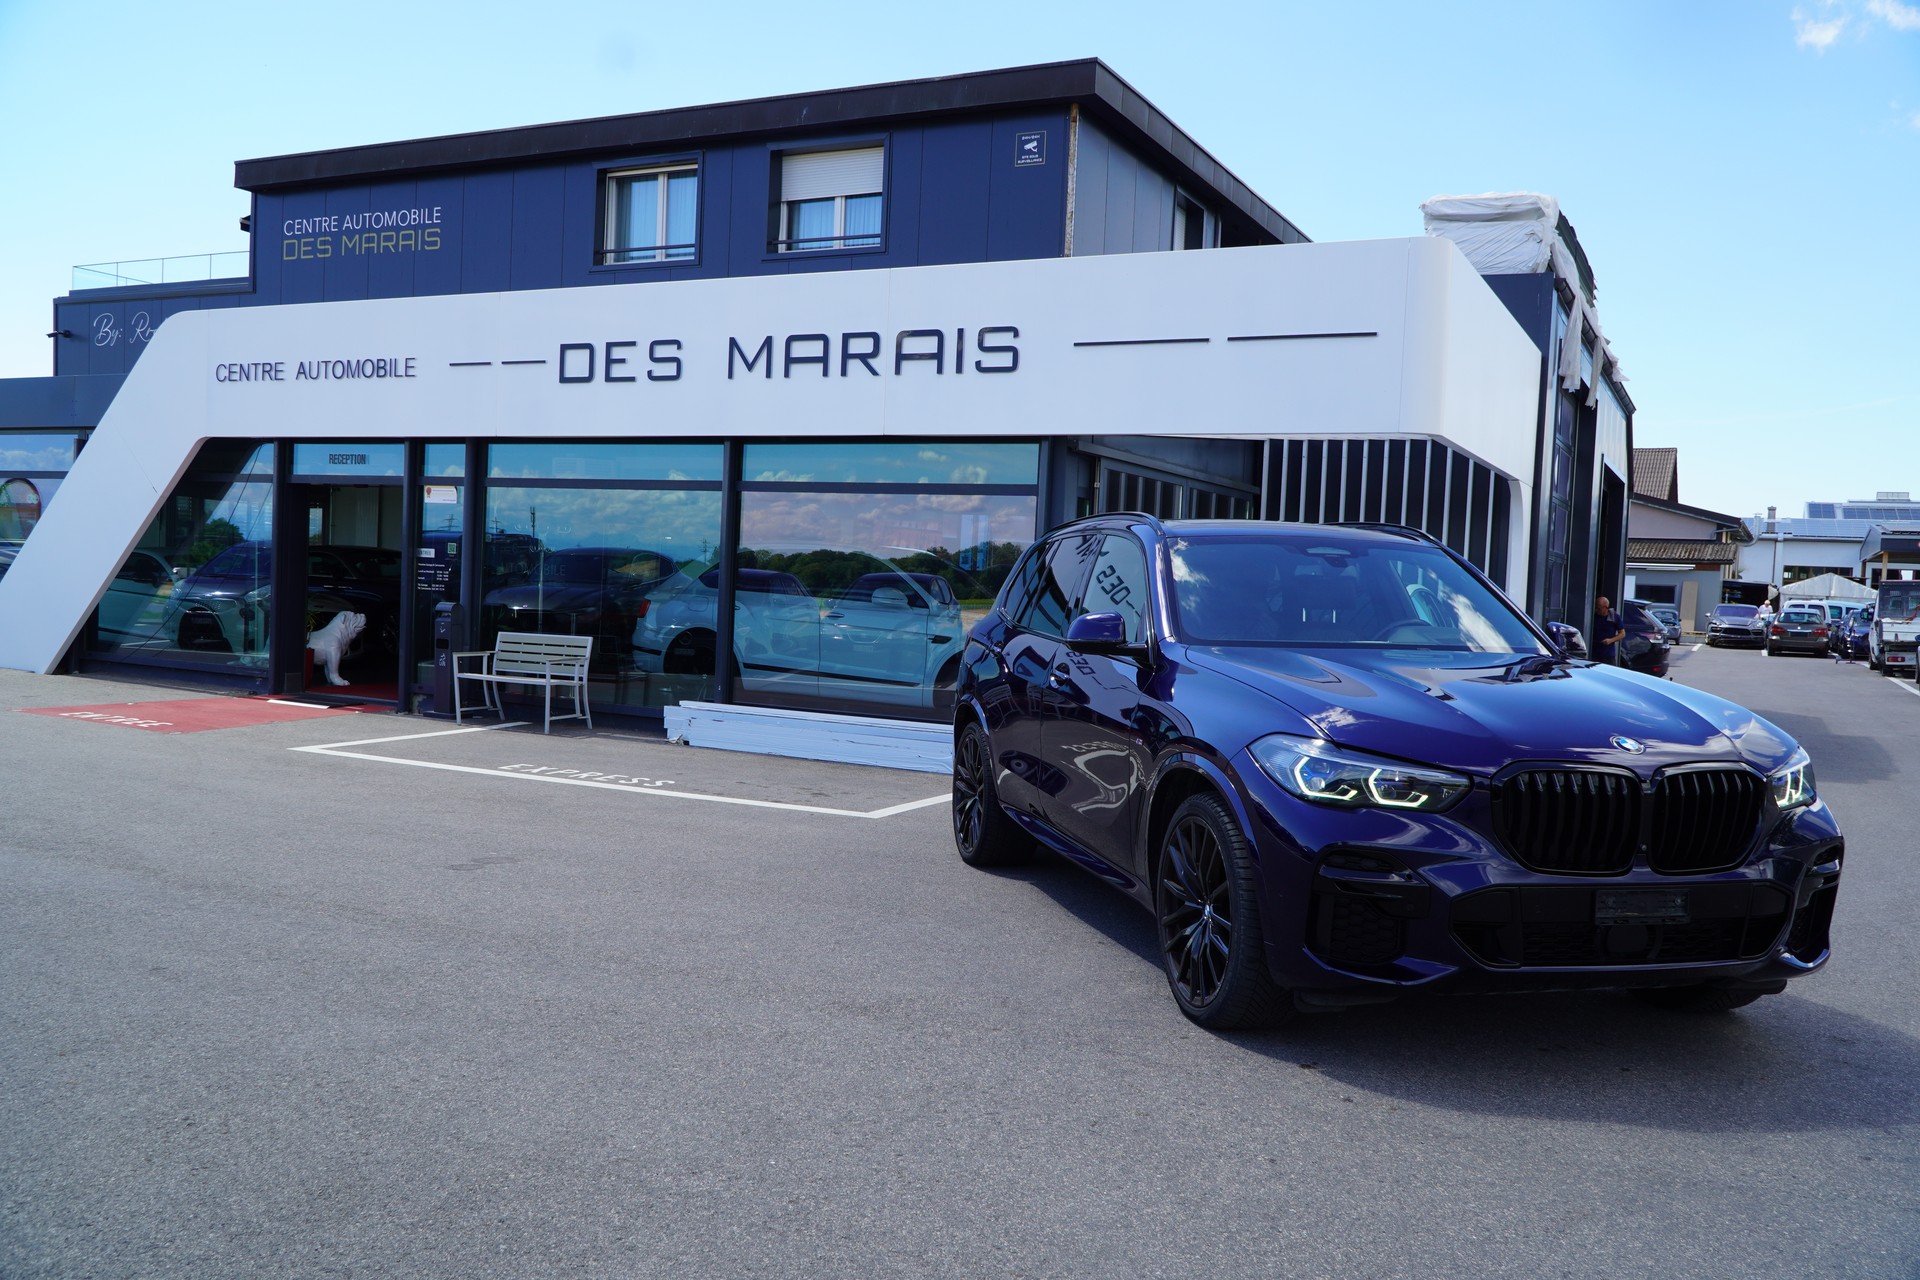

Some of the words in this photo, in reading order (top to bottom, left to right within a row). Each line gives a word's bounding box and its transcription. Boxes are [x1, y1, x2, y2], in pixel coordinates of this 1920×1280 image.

[283, 216, 339, 236] CENTRE
[342, 207, 442, 231] AUTOMOBILE
[283, 236, 332, 261] DES
[341, 228, 441, 256] MARAIS
[215, 361, 286, 383] CENTRE
[295, 357, 417, 381] AUTOMOBILE
[558, 338, 683, 384] DES
[727, 325, 1020, 380] MARAIS
[328, 453, 367, 465] RECEPTION
[498, 763, 676, 787] EXPRESS
